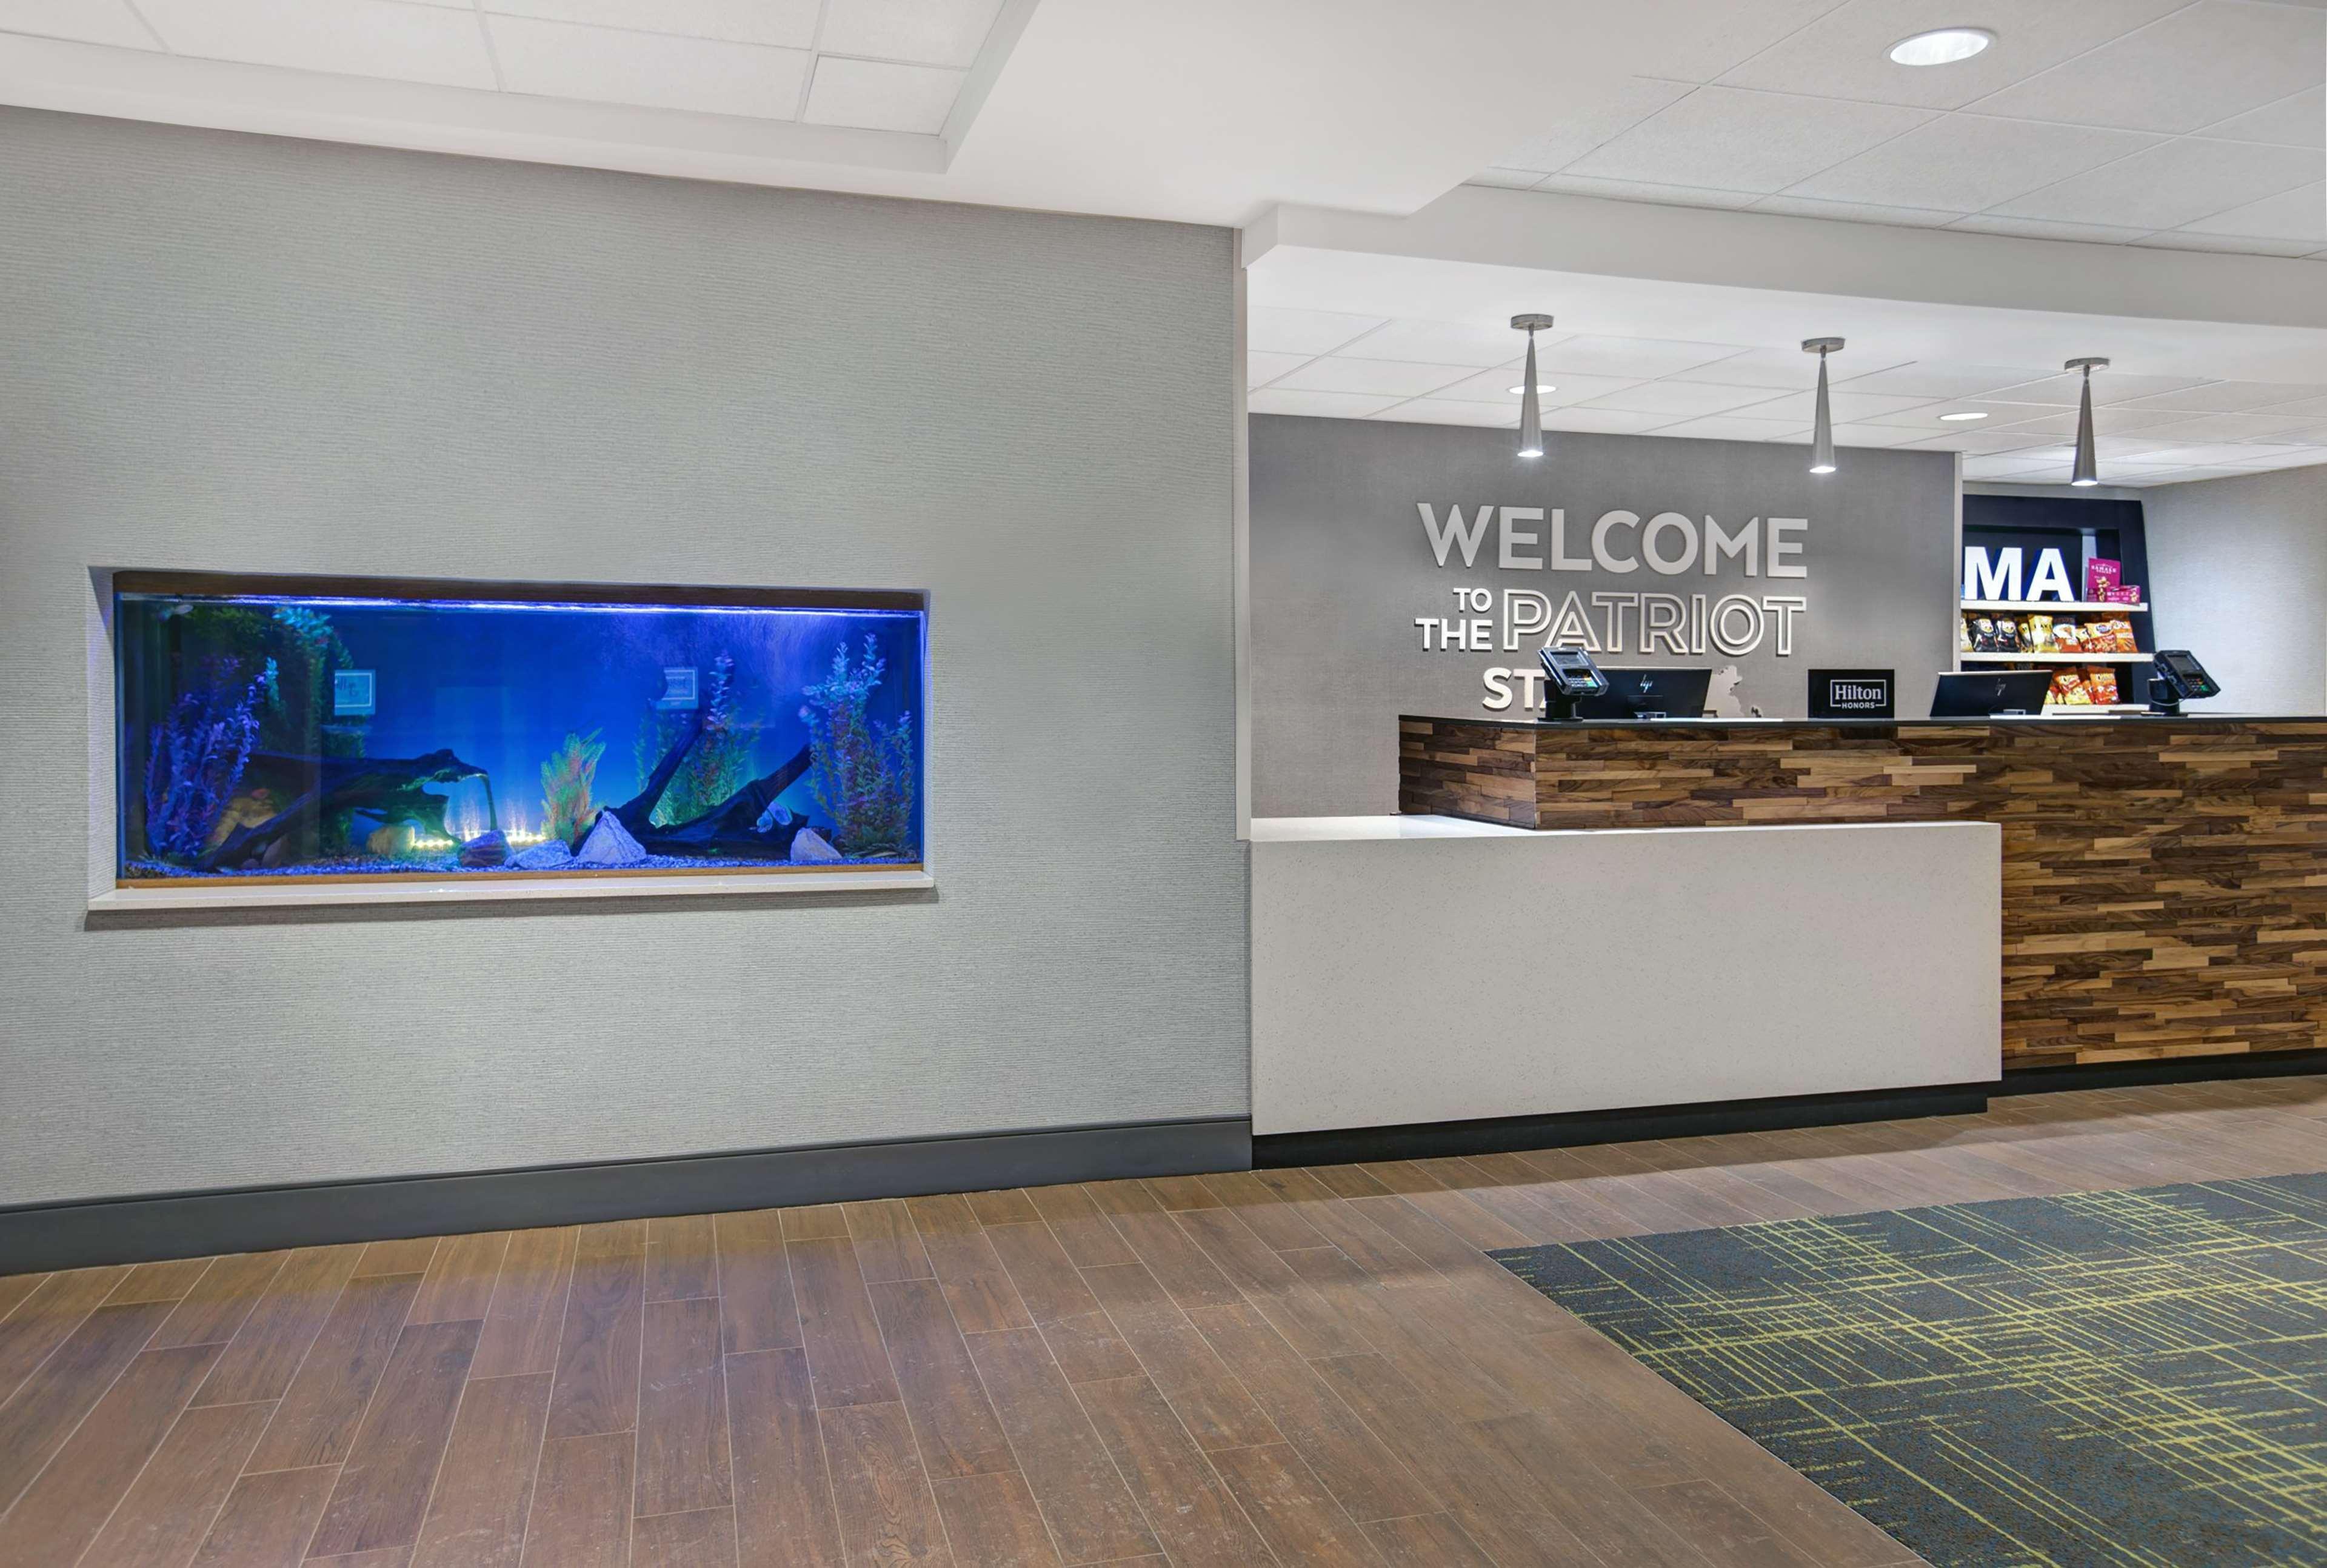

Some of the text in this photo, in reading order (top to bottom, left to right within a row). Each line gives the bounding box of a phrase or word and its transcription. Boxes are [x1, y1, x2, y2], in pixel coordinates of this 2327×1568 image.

[1417, 502, 1808, 578] WELCOME
[1965, 546, 2074, 601] MA
[1415, 589, 1807, 655] THE PATRIOT
[1453, 588, 1492, 612] TO
[1482, 667, 1546, 709] ST
[1835, 684, 1881, 700] Hilton
